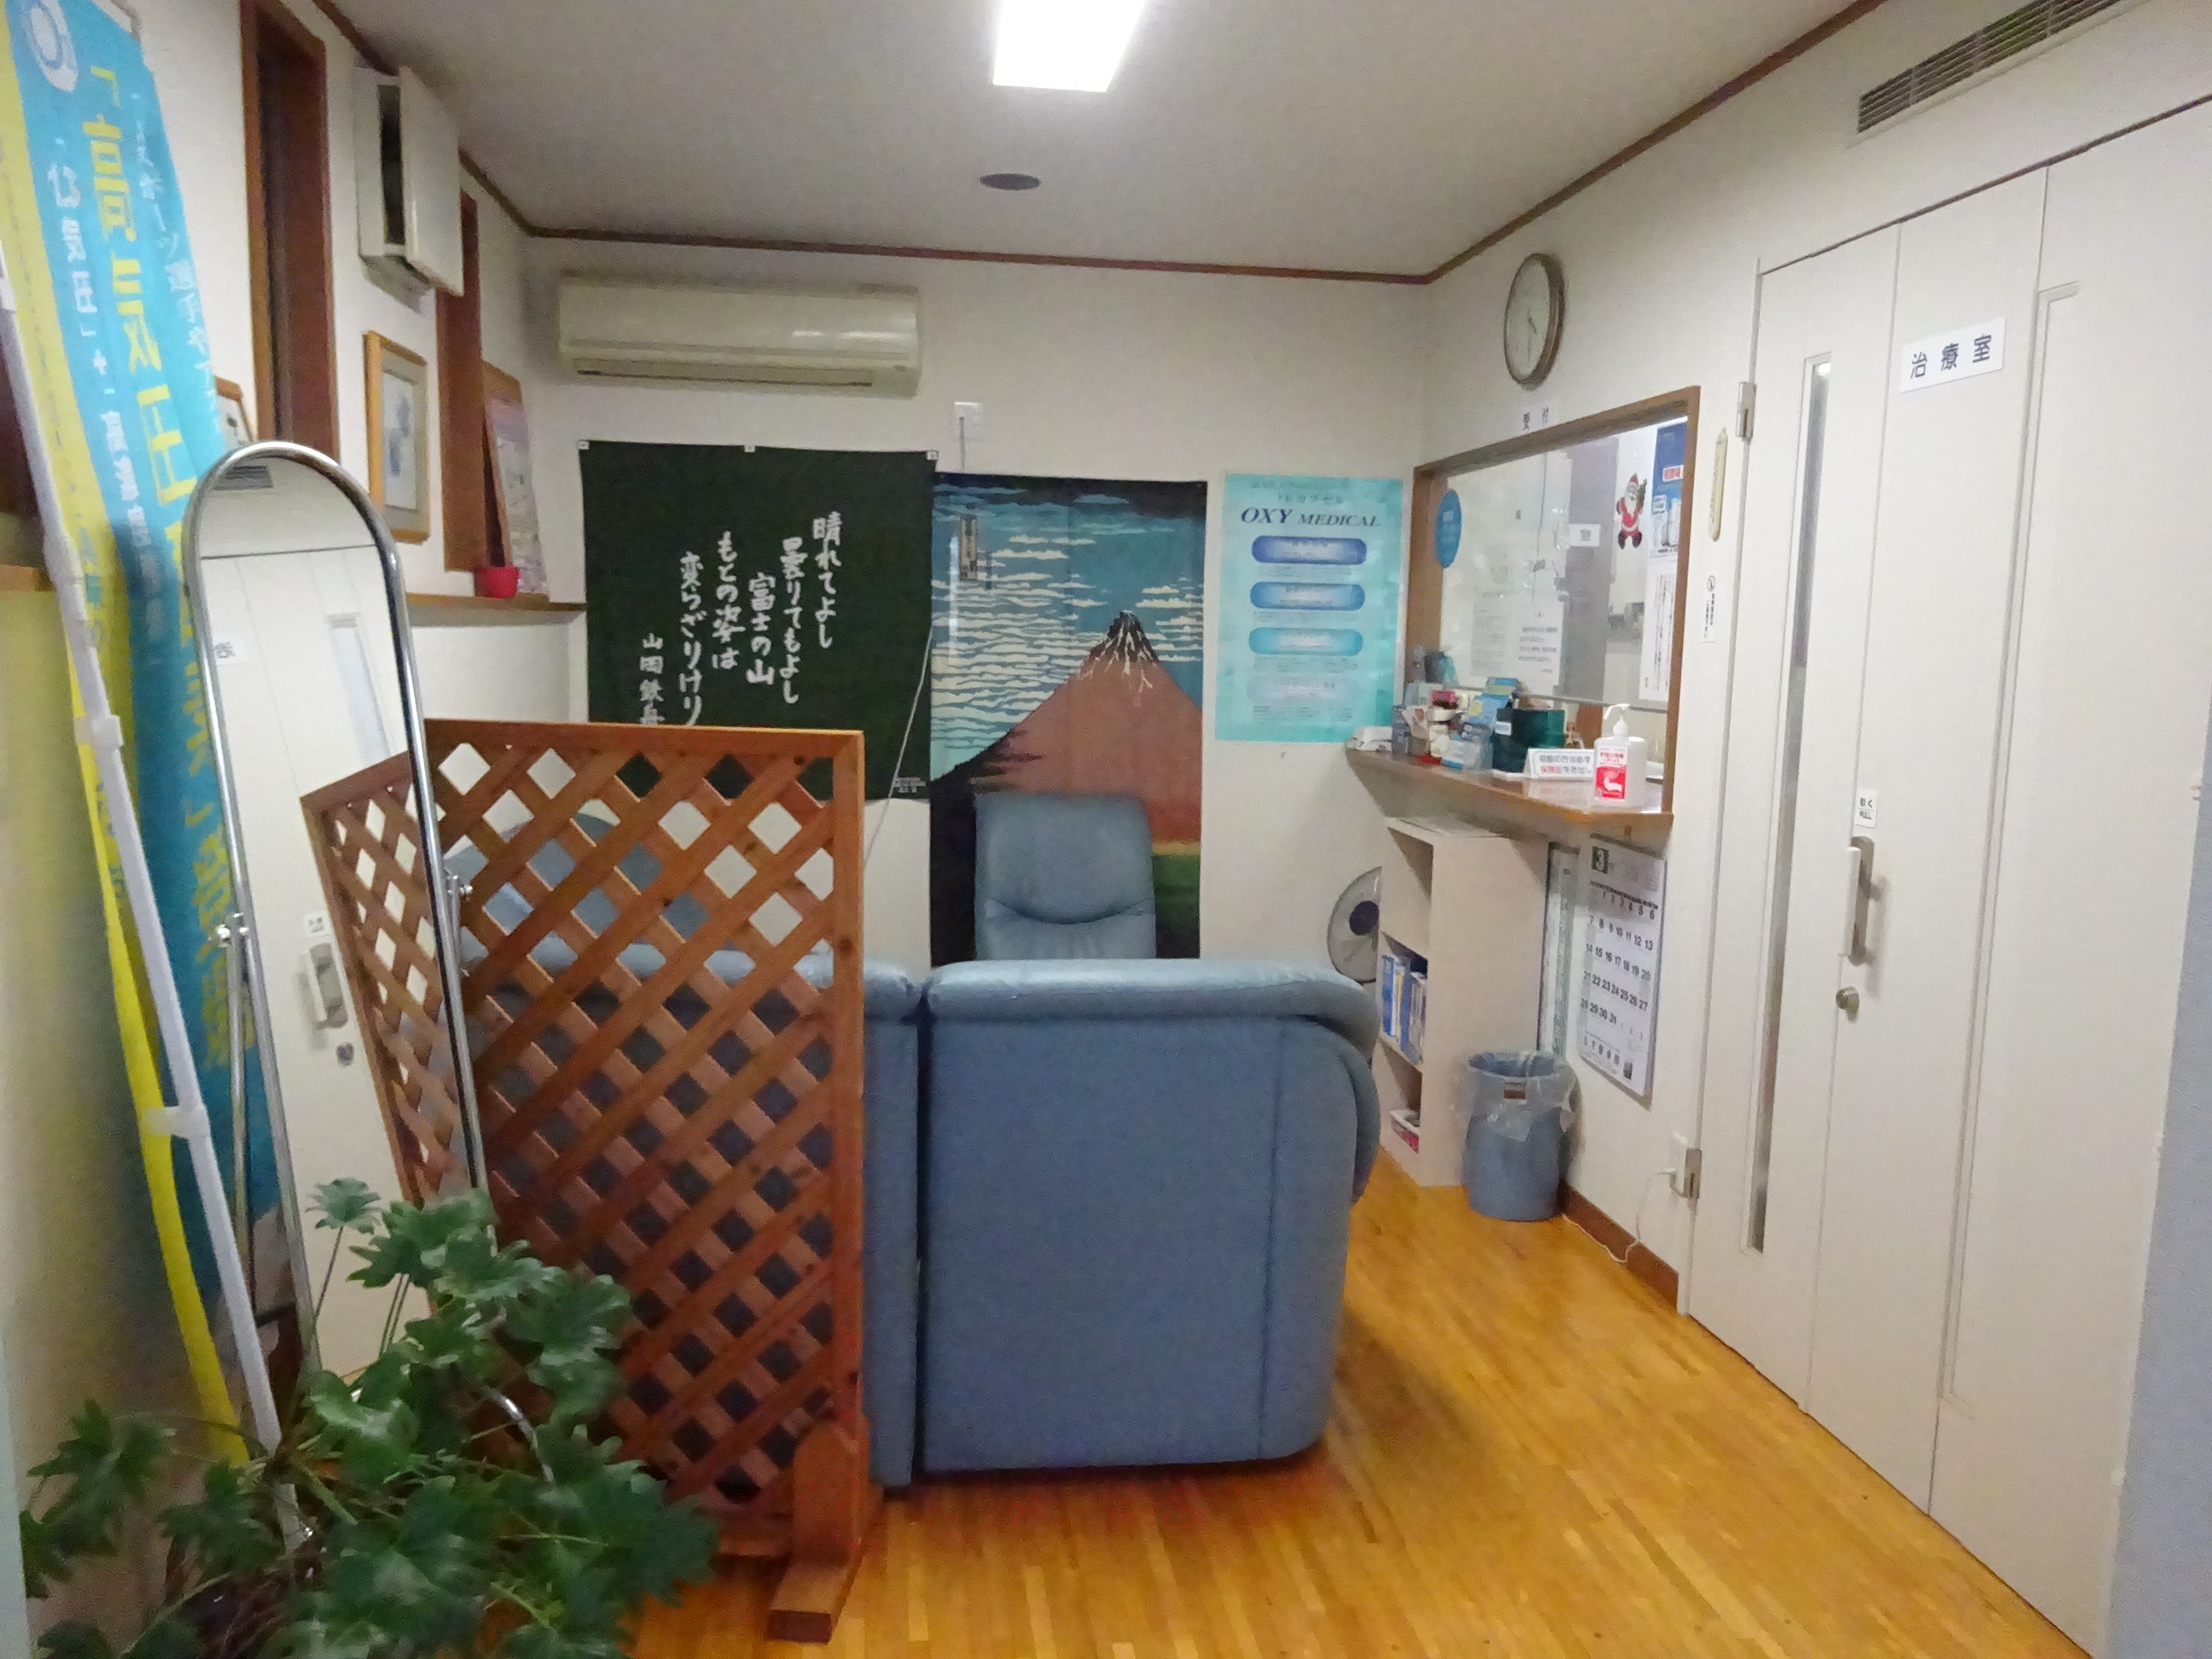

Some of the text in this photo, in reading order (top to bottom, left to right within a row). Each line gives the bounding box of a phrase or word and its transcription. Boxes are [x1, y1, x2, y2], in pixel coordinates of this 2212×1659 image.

[1910, 334, 1993, 380] 治療室
[1241, 506, 1382, 528] OXY MEDICAL
[711, 530, 747, 671] もとの姿は
[812, 510, 843, 649] 晴れてよし
[678, 550, 707, 725] 変らざりけり
[745, 572, 776, 685] 富士の山
[779, 536, 808, 705] 曇りてもよし
[1639, 905, 1643, 916] 5
[1650, 909, 1655, 920] 6
[1599, 918, 1604, 928] 8
[1626, 931, 1631, 941] 11
[1634, 934, 1641, 946] 12
[1645, 940, 1653, 951] 13
[1586, 943, 1650, 981] 14 15 16 17 18 19 20
[1584, 970, 1648, 1011] 21 22 23 24 25 26 27
[1590, 1002, 1598, 1014] 29
[1599, 1007, 1607, 1020] 30
[1610, 1012, 1616, 1025] 31
